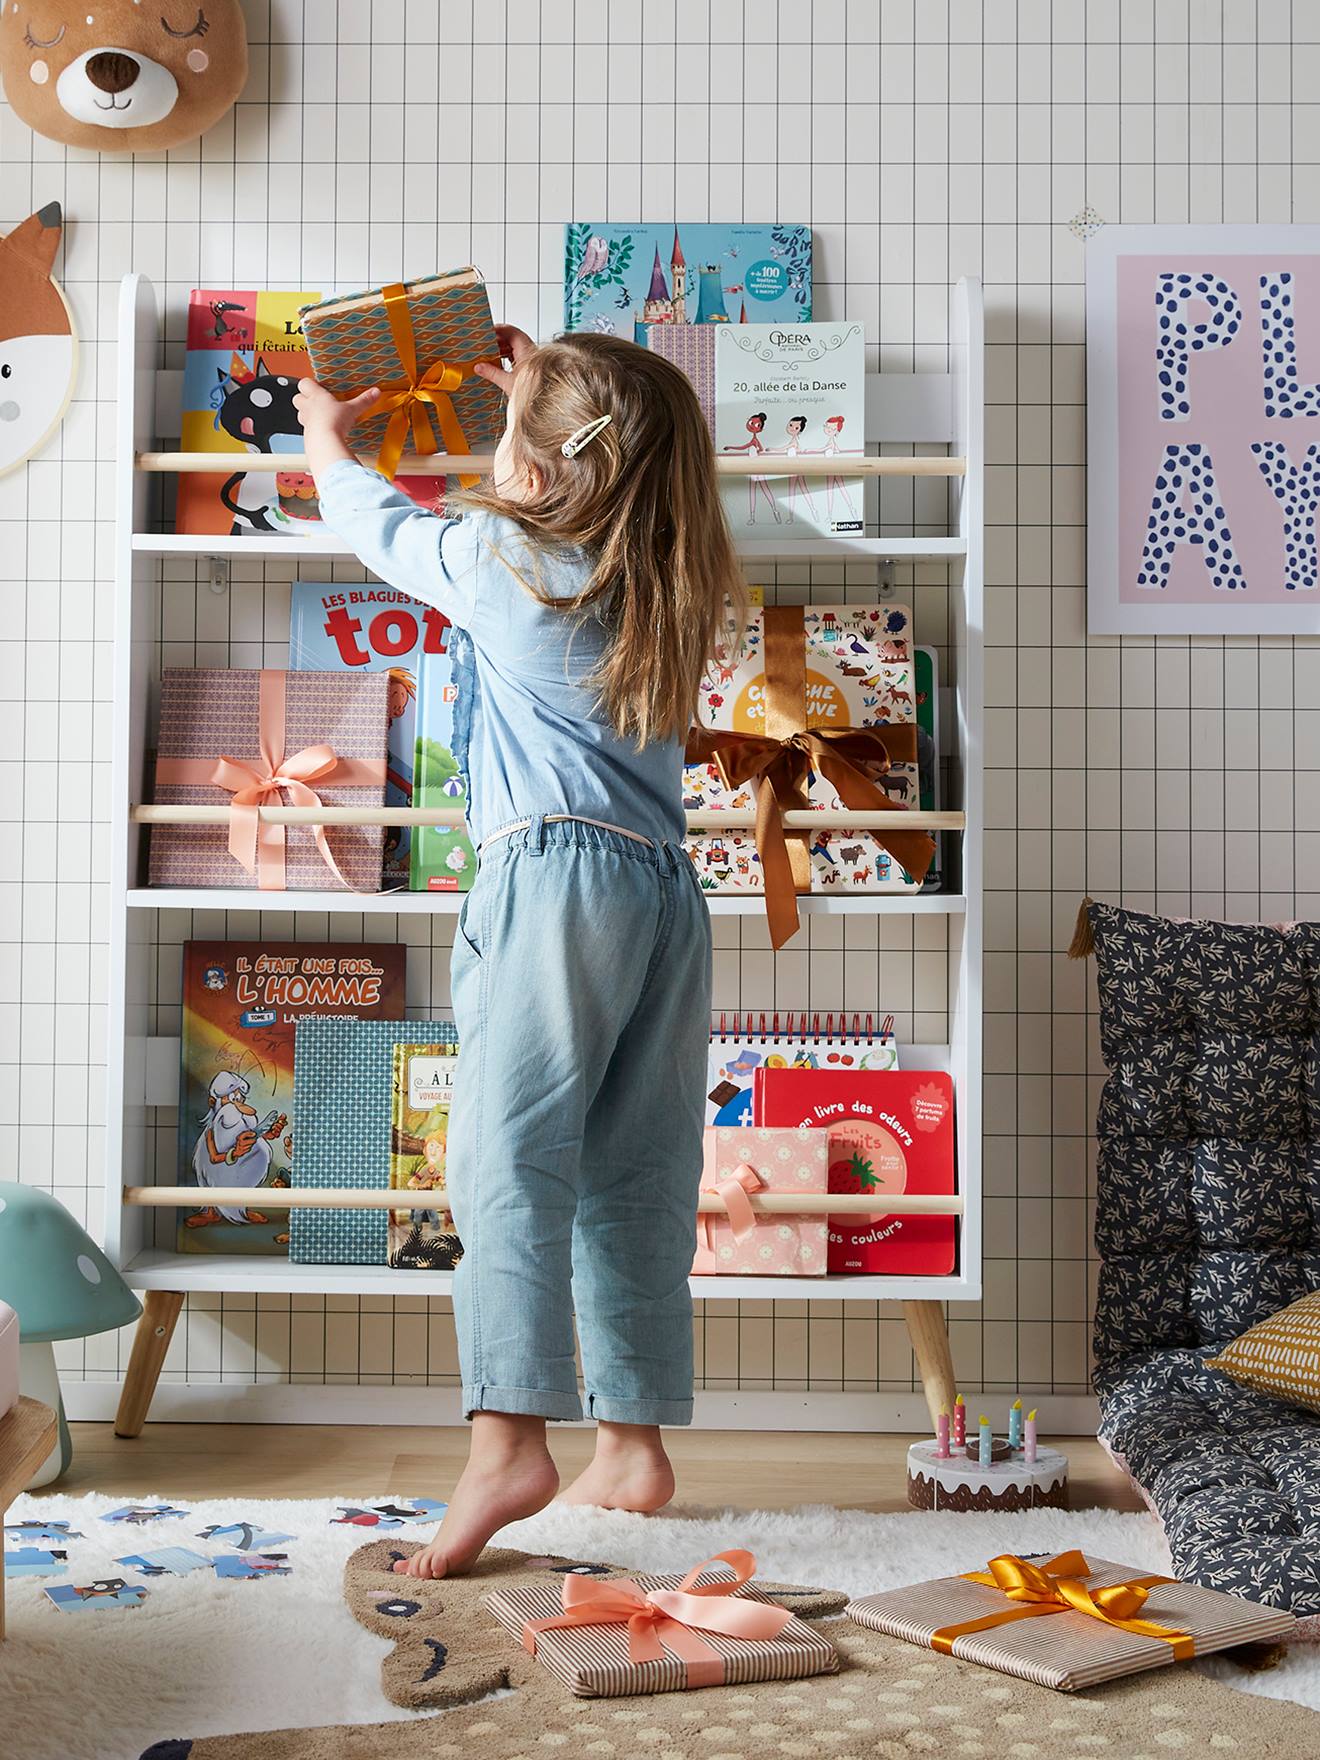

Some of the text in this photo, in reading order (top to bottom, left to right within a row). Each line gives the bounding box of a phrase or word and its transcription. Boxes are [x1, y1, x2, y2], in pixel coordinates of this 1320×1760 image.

[762, 266, 780, 278] 100
[238, 341, 259, 355] qui
[263, 339, 296, 352] fêtait
[1156, 272, 1320, 422] PL
[733, 381, 847, 392] 20, allée de la Danse
[1136, 442, 1320, 590] AY
[321, 593, 346, 609] LES
[349, 591, 411, 604] BLAGUES
[323, 607, 453, 667] tot
[746, 703, 765, 718] et
[236, 957, 251, 973] IL
[254, 954, 299, 975] ÉTAIT
[301, 958, 335, 975] UNE
[338, 959, 384, 975] FOIS...
[237, 975, 382, 1006] L'HOMME
[283, 1013, 296, 1023] LA
[431, 1070, 440, 1086] À
[419, 1092, 442, 1101] VOYAGE
[797, 1100, 913, 1147] on livre des odeurs
[829, 1132, 882, 1149] Fruits
[829, 1220, 903, 1245] es couleurs
